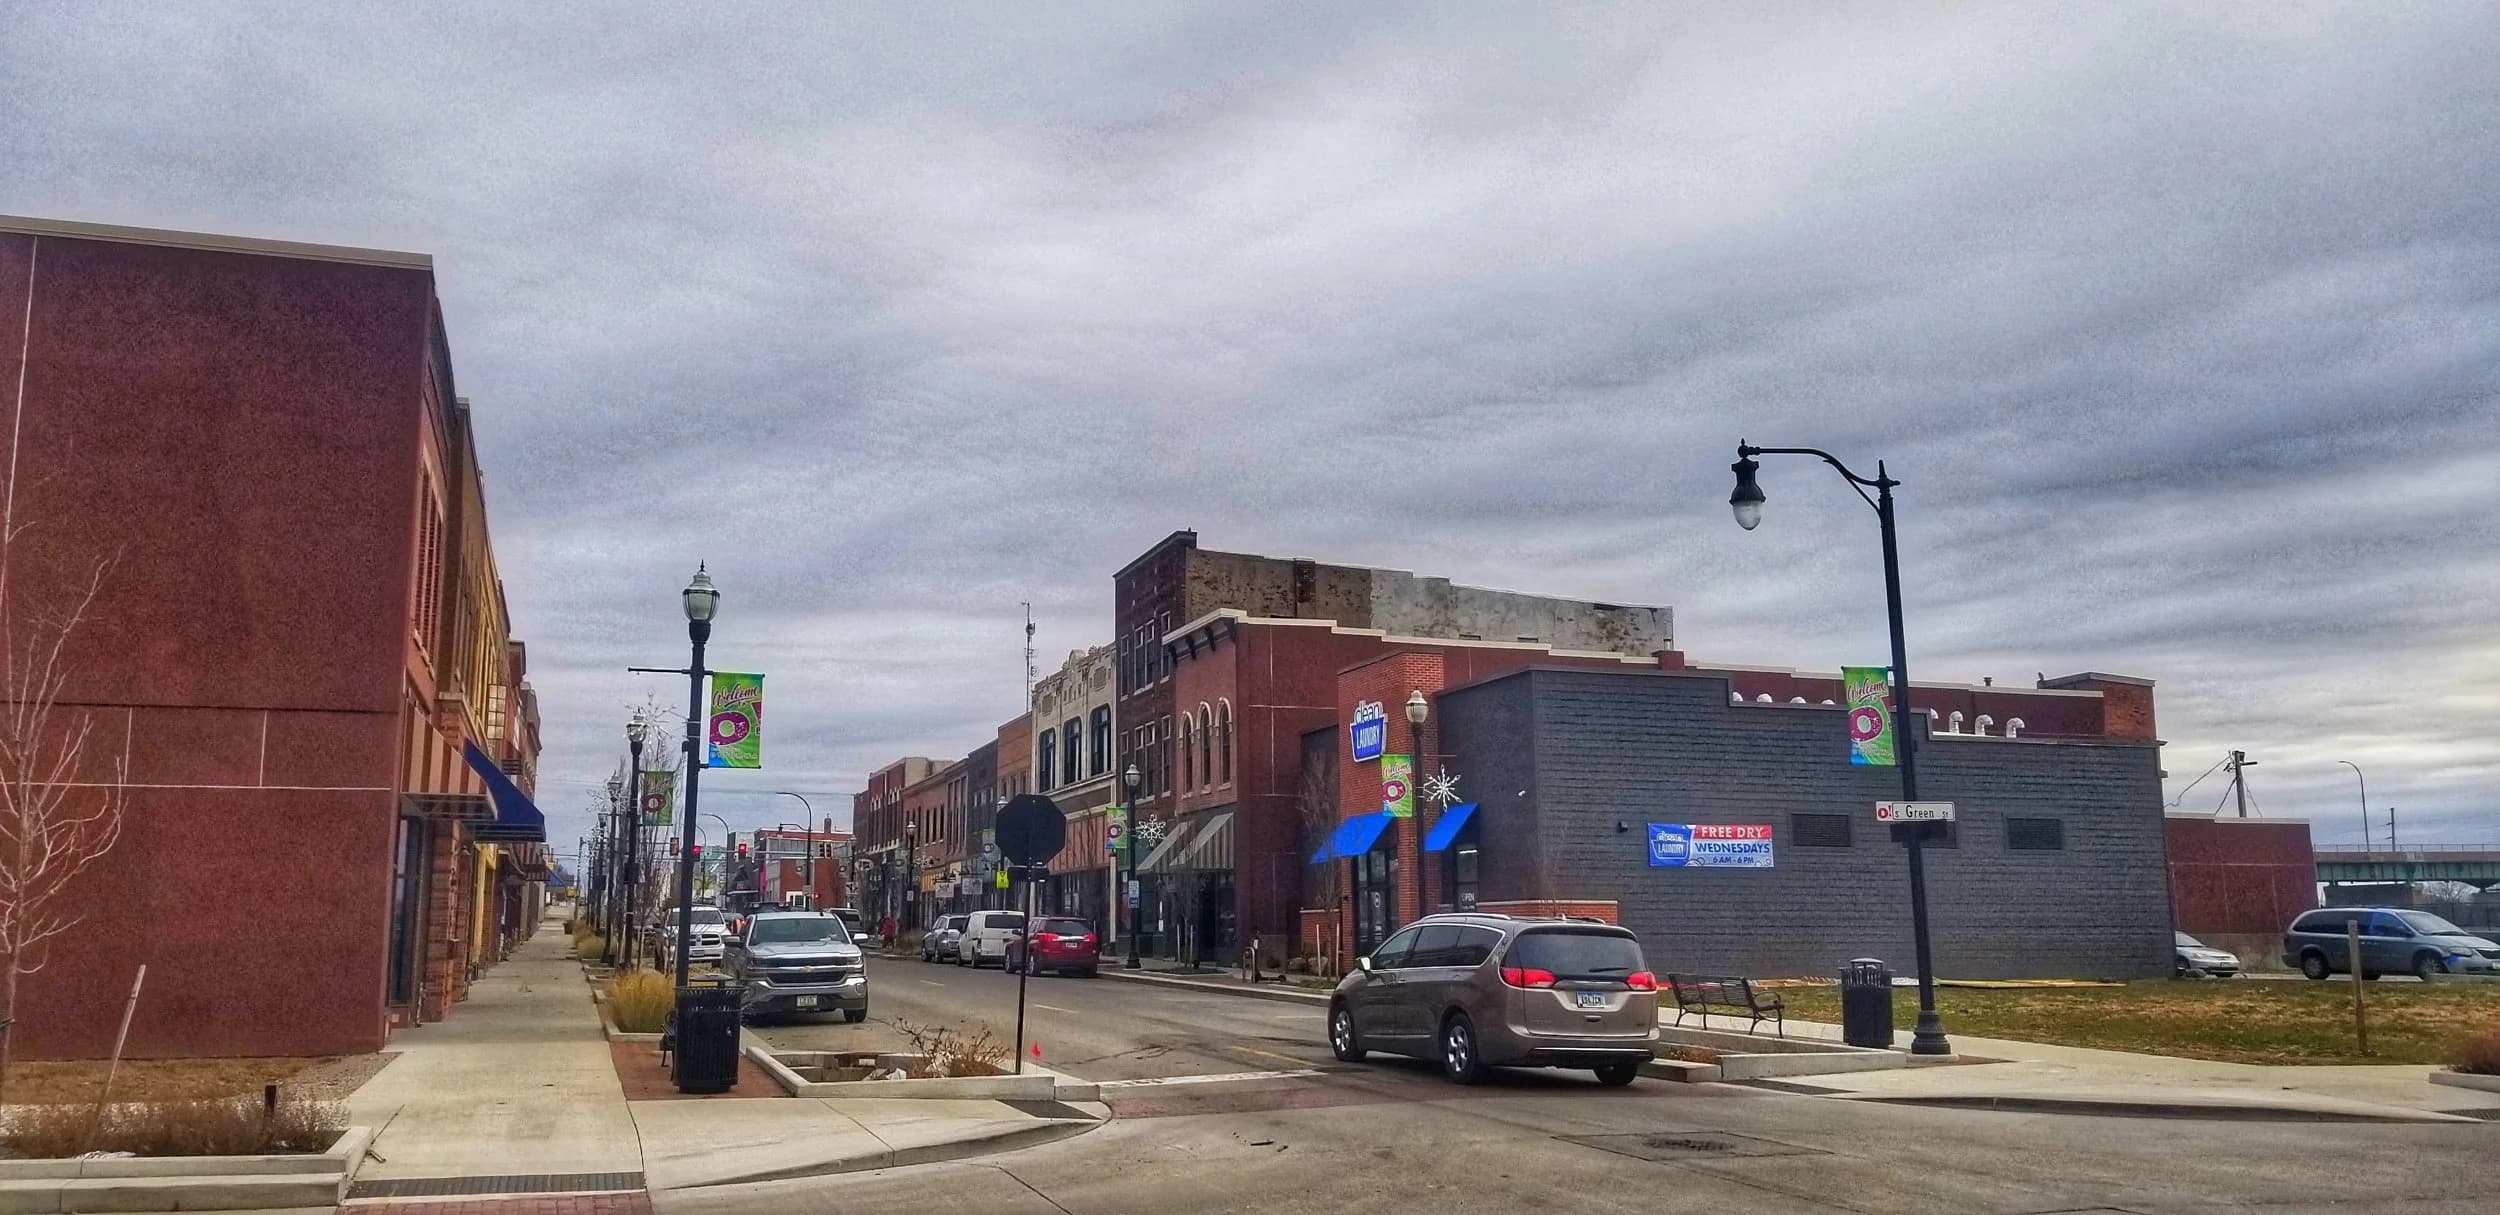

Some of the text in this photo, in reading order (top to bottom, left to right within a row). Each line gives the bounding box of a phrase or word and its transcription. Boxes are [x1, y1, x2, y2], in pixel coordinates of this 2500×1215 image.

[1847, 678, 1887, 702] Welcome
[1356, 703, 1380, 723] clean
[1357, 725, 1380, 749] LAUNDRY
[1905, 804, 1935, 818] Green
[1701, 827, 1763, 838] FREE DRY
[1657, 843, 1684, 855] LAUNDRY
[1694, 842, 1770, 854] WEDNESDAYS
